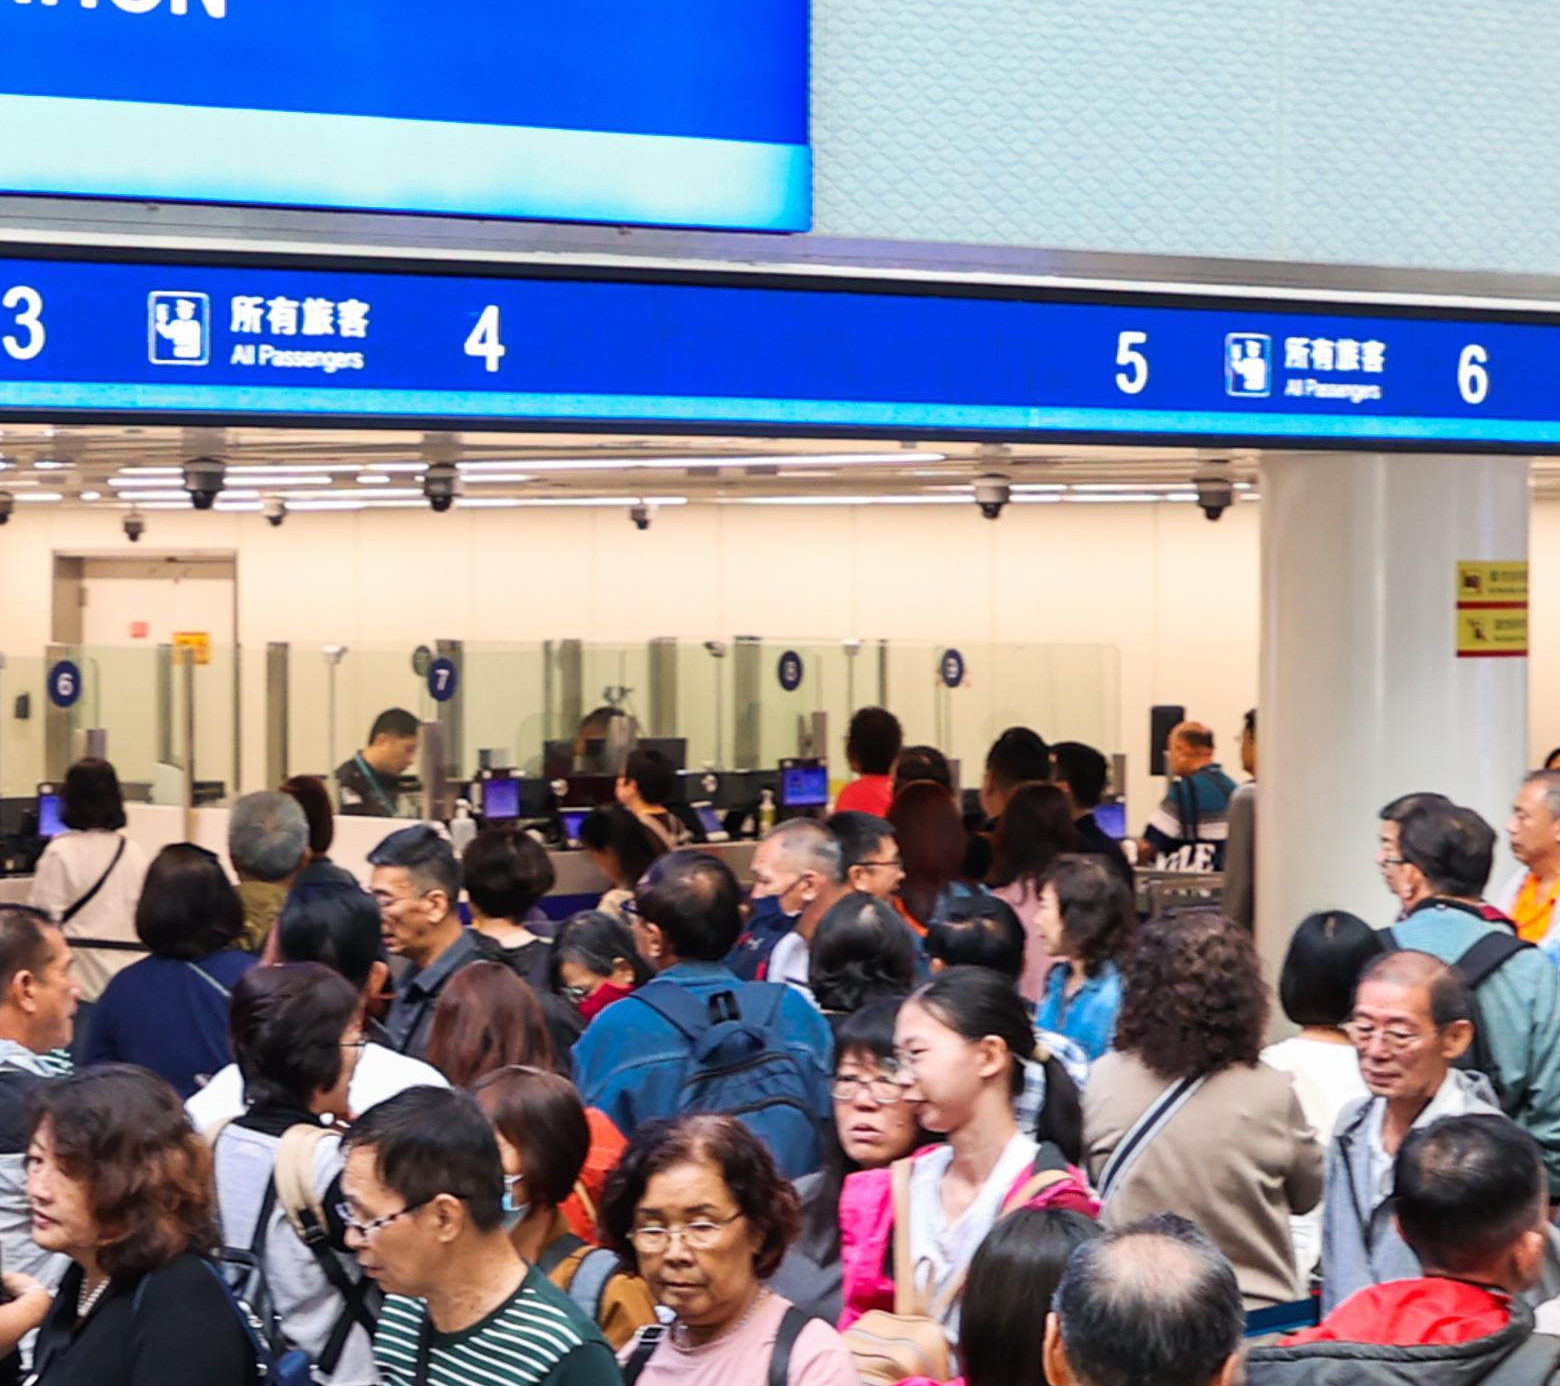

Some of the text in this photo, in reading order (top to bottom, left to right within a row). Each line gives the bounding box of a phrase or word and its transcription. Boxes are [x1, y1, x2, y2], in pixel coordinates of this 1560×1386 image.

[1, 284, 46, 361] 3
[230, 295, 370, 338] 所有旅客
[463, 304, 506, 373] 4
[258, 343, 365, 374] Passengers
[1114, 330, 1149, 395] 5
[1457, 344, 1489, 405] 6
[57, 673, 73, 696] 6
[435, 667, 450, 691] 7
